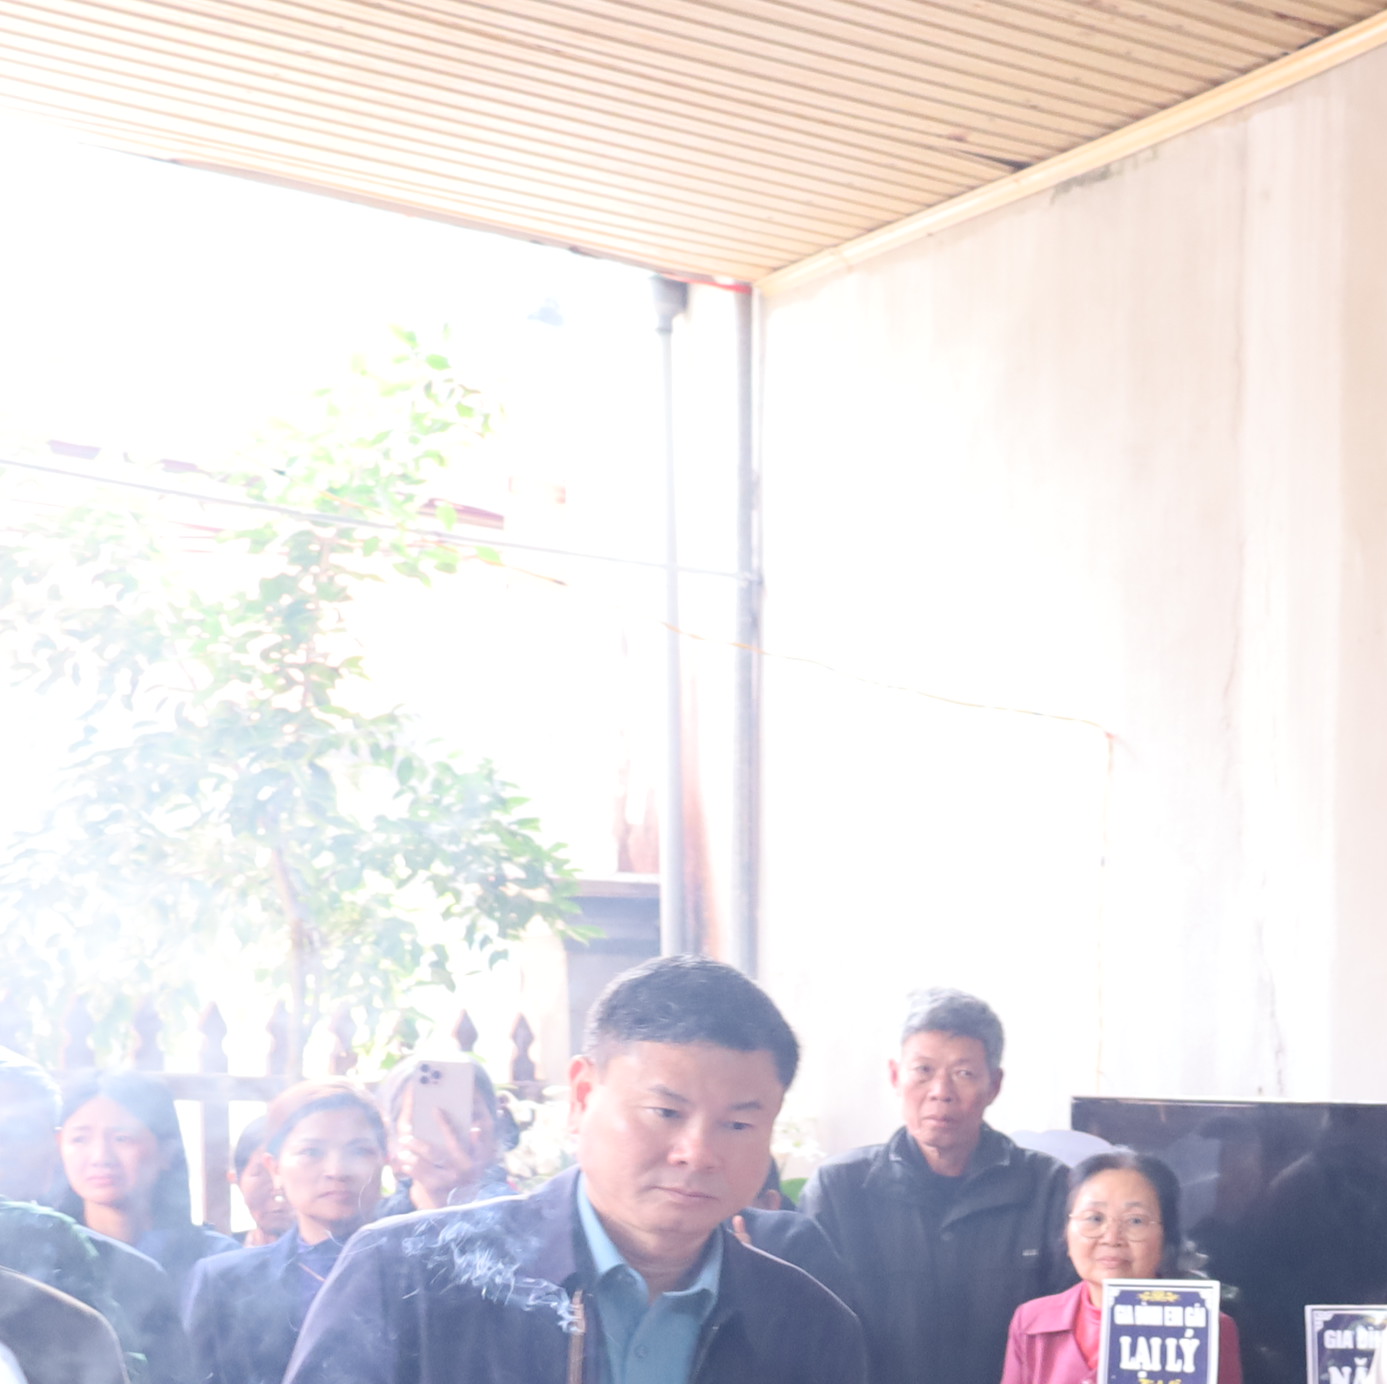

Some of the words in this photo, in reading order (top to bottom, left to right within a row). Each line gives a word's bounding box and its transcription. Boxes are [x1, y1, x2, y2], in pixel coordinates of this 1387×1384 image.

[1119, 1336, 1162, 1379] LẠI
[1164, 1328, 1201, 1373] LÝ
[1323, 1329, 1354, 1349] GIA
